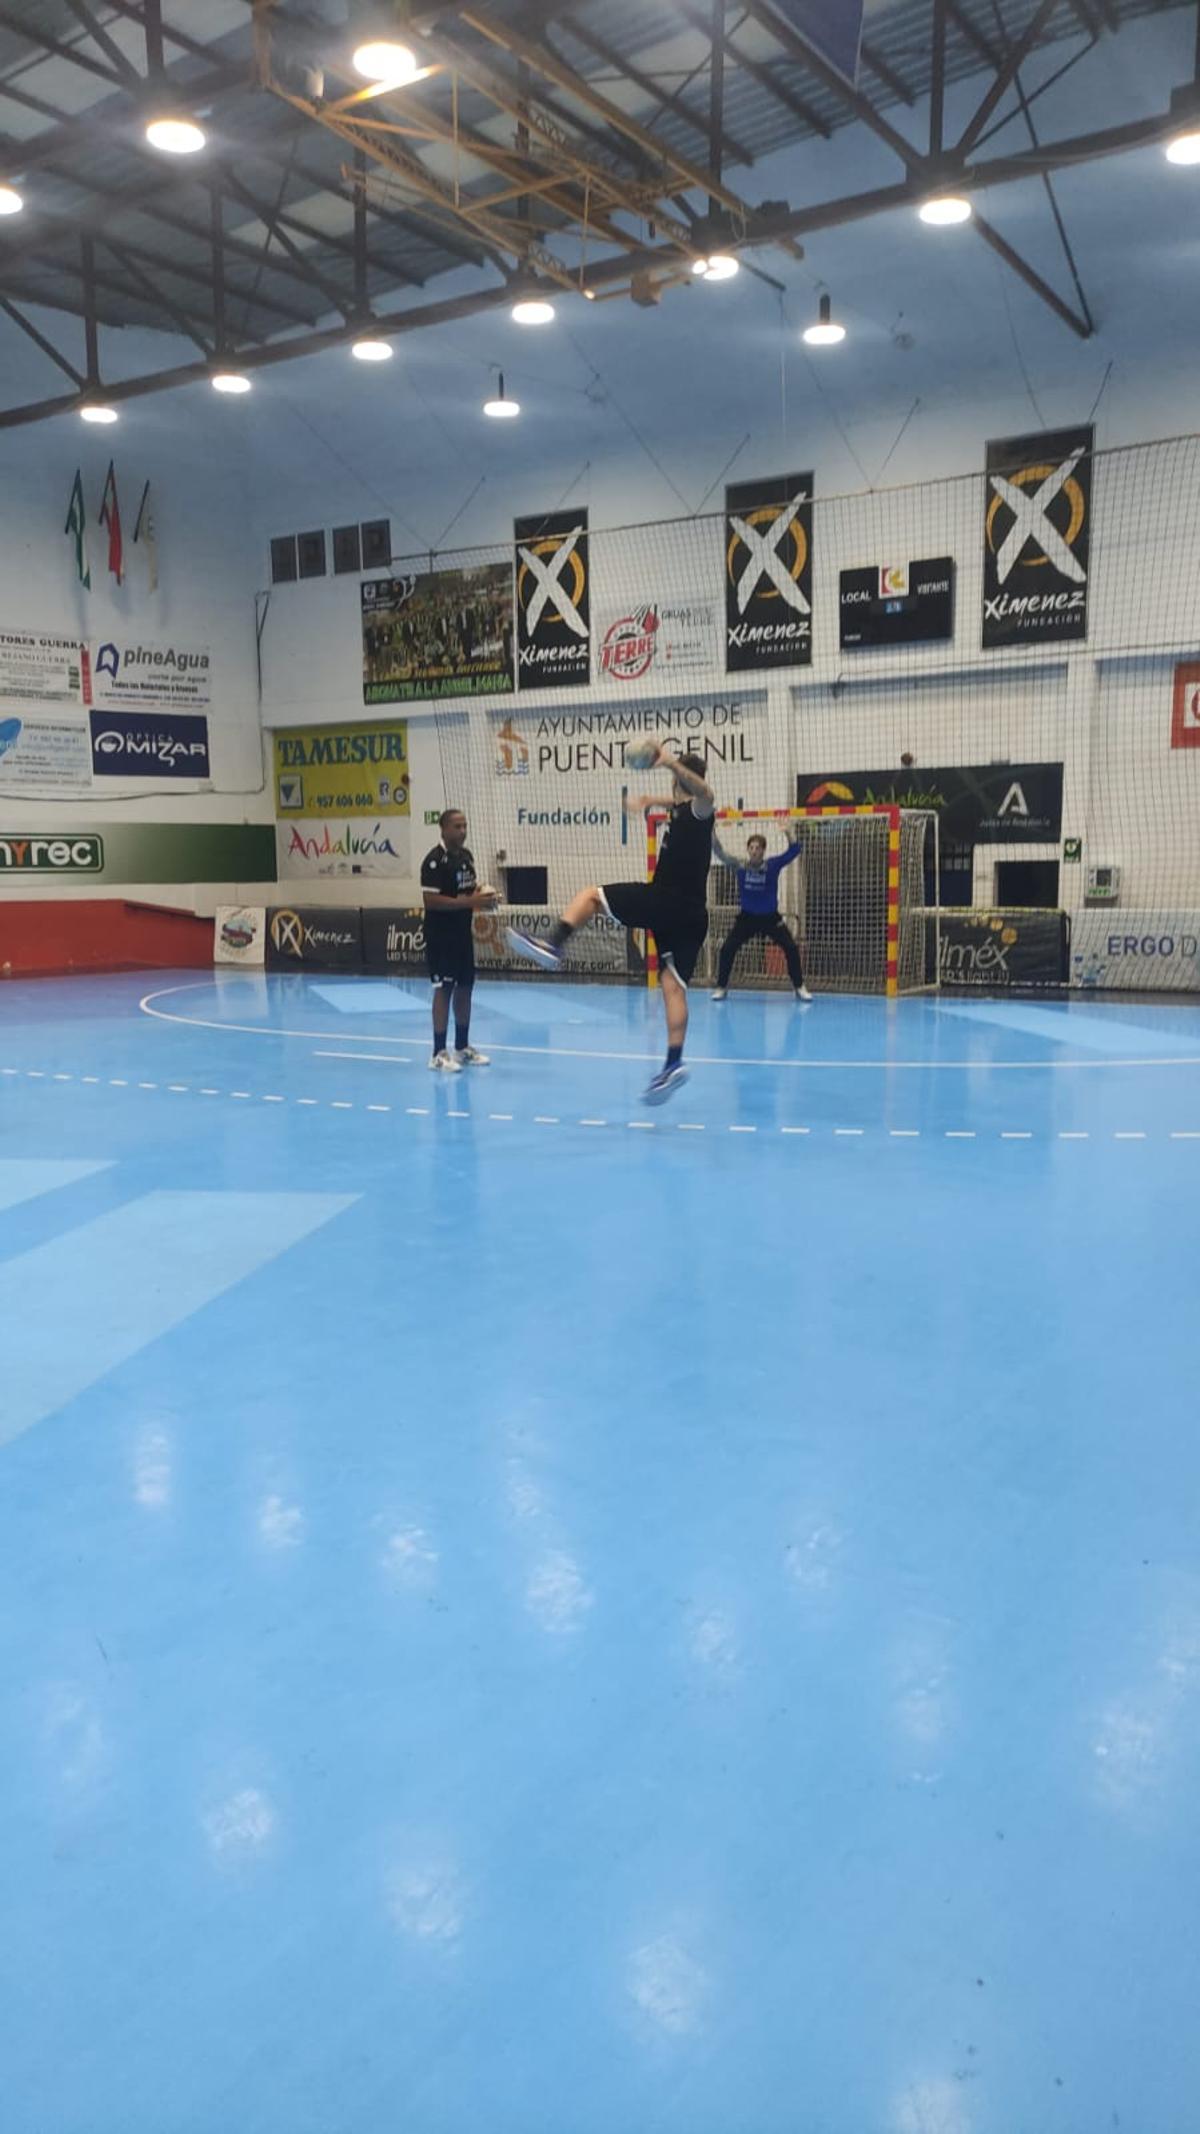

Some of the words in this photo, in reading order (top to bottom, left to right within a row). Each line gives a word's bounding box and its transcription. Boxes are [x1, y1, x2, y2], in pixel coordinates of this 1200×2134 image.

[841, 591, 872, 604] LOCAL
[984, 590, 1085, 621] Ximenez
[40, 639, 86, 650] GUERRA
[728, 621, 811, 648] Ximenez
[123, 645, 210, 672] pineAgua
[519, 643, 589, 666] Ximenez
[537, 706, 703, 738] AYUNTAMIENTO
[713, 705, 741, 726] DE
[127, 739, 206, 767] MIZAR
[278, 733, 406, 766] TAMESUR
[539, 741, 628, 773] PUENT
[518, 808, 610, 825] Fundación
[288, 823, 399, 860] Andalucía
[387, 923, 427, 951] ilmé
[1107, 935, 1175, 957] ERGO
